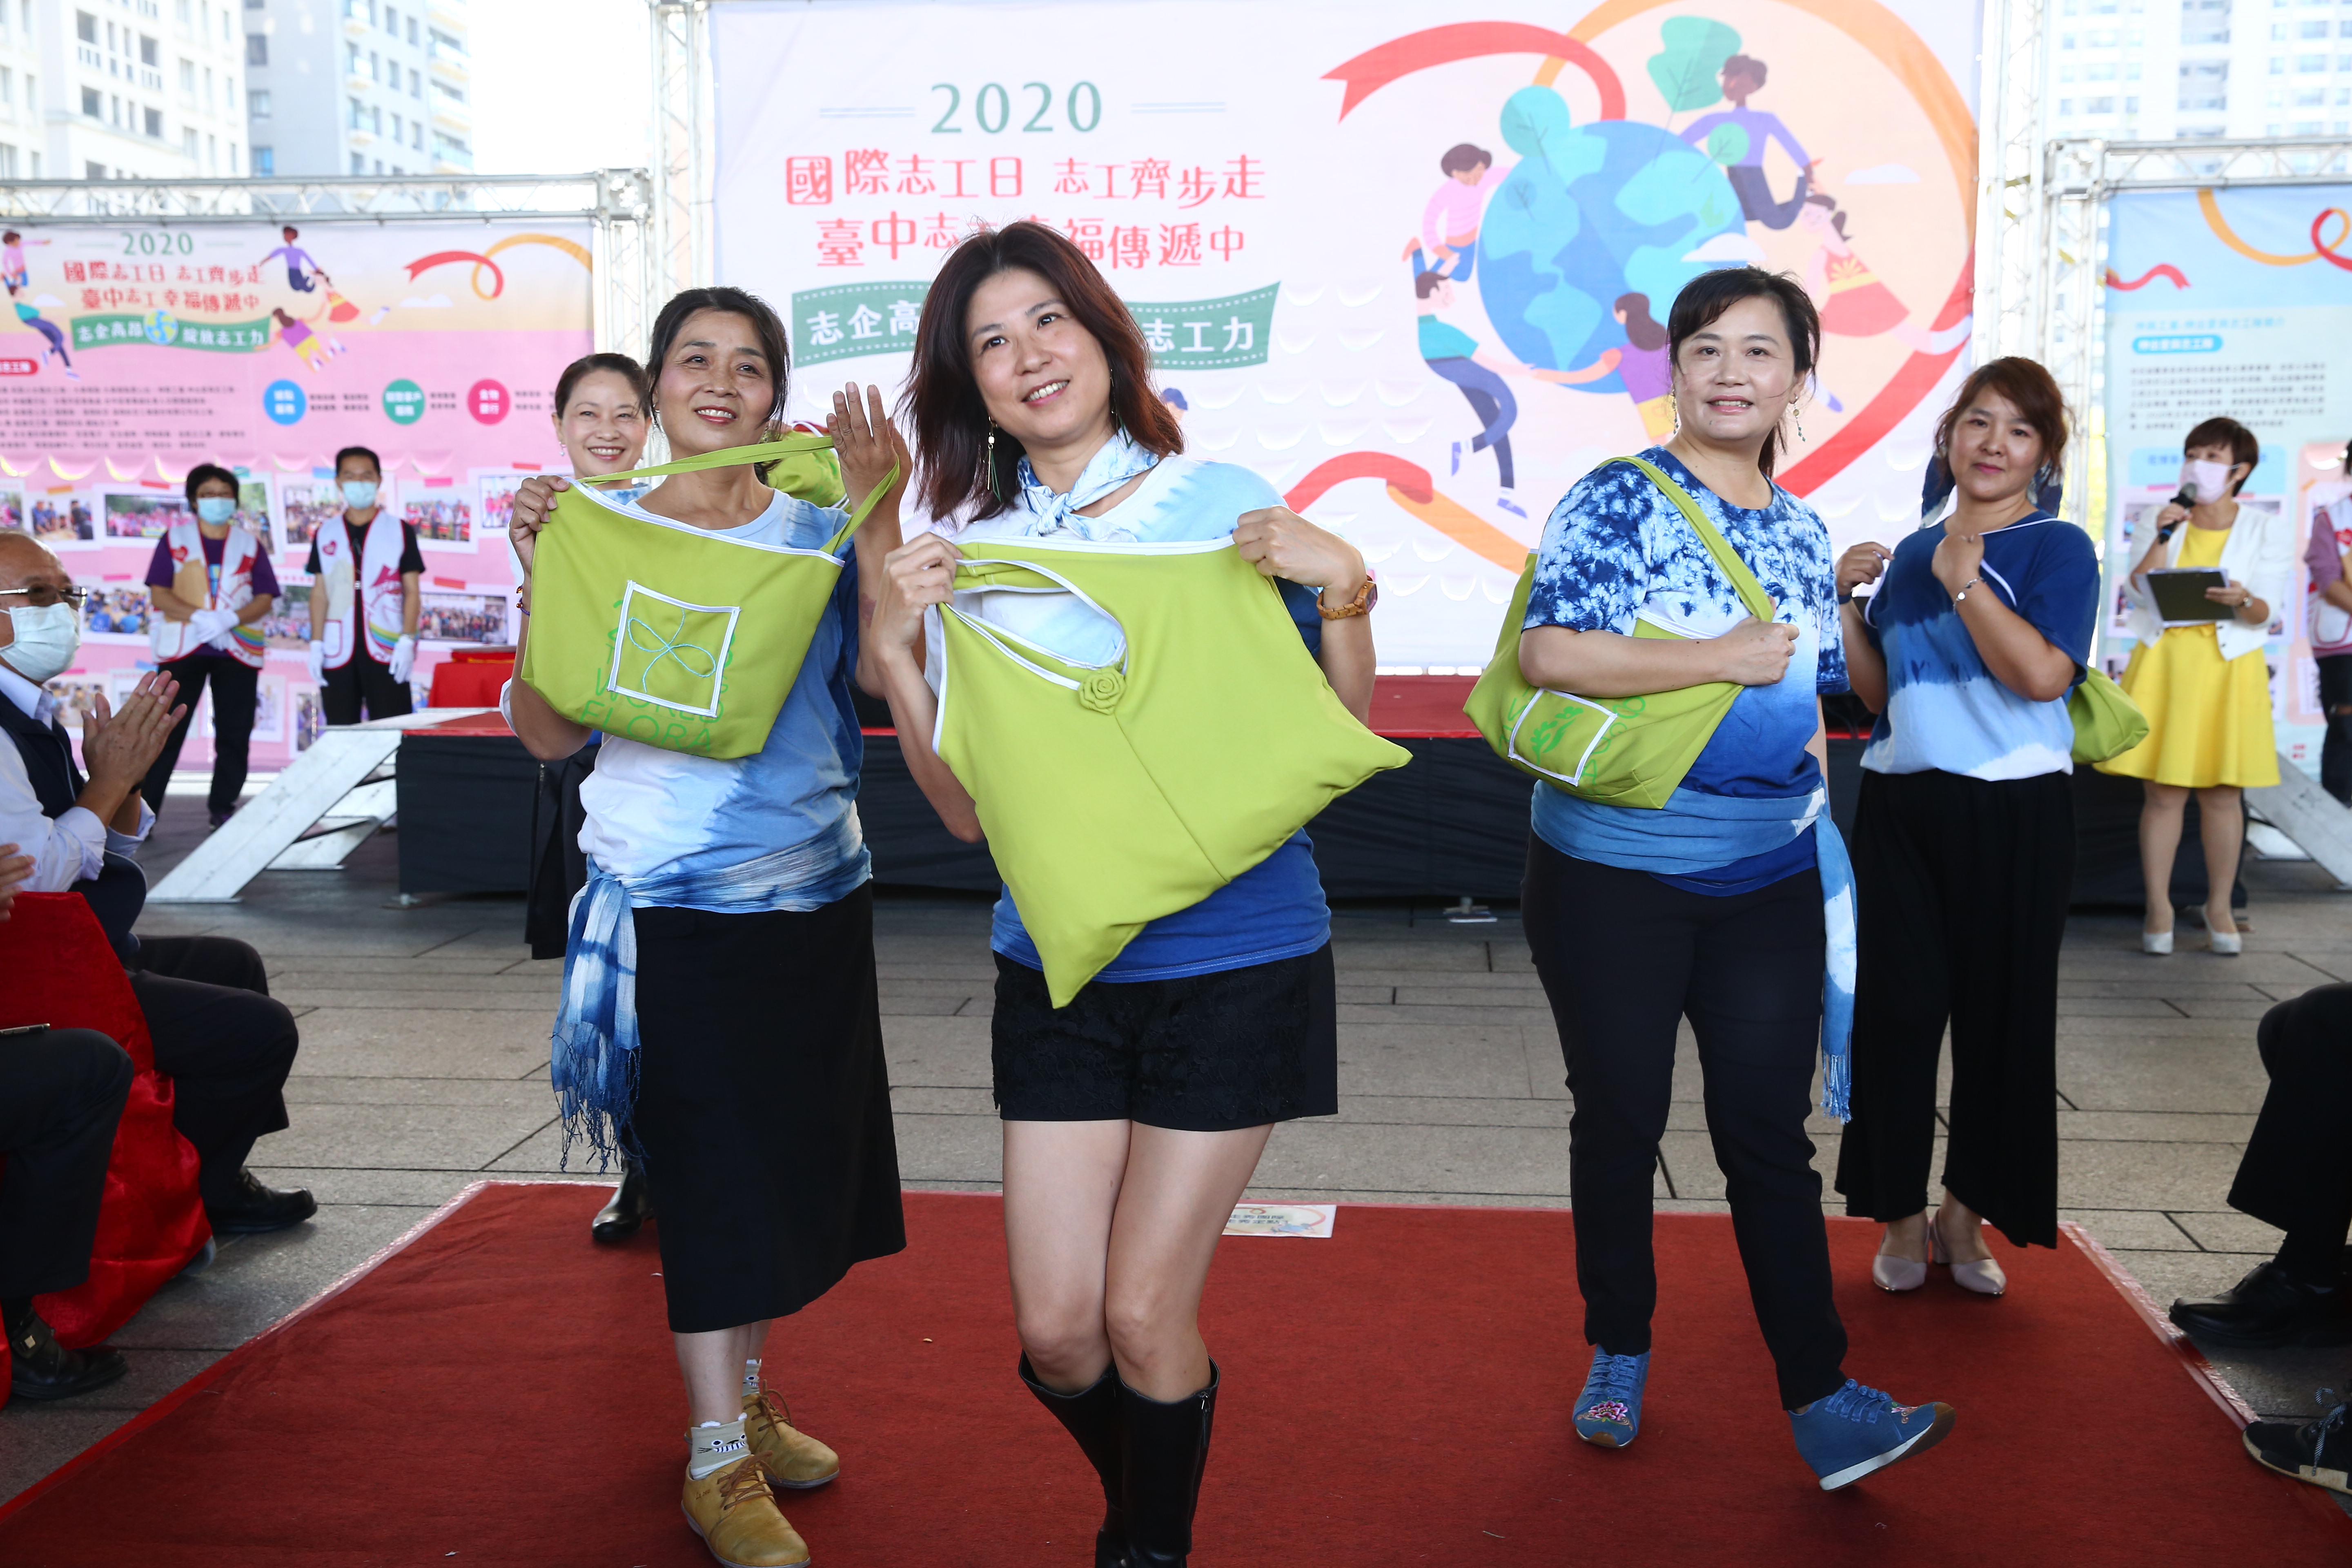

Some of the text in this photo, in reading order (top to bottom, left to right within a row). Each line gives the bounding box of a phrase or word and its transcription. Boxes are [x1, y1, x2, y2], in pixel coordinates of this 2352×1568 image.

[931, 80, 1102, 134] 2020
[785, 147, 1266, 210] 國際志工日 志工齊步走
[120, 230, 194, 256] 2020
[815, 210, 1245, 270] 臺中志福傳遞中
[63, 260, 166, 283] 國際志工日
[1142, 316, 1254, 353] 志工力
[579, 700, 711, 752] FLORA
